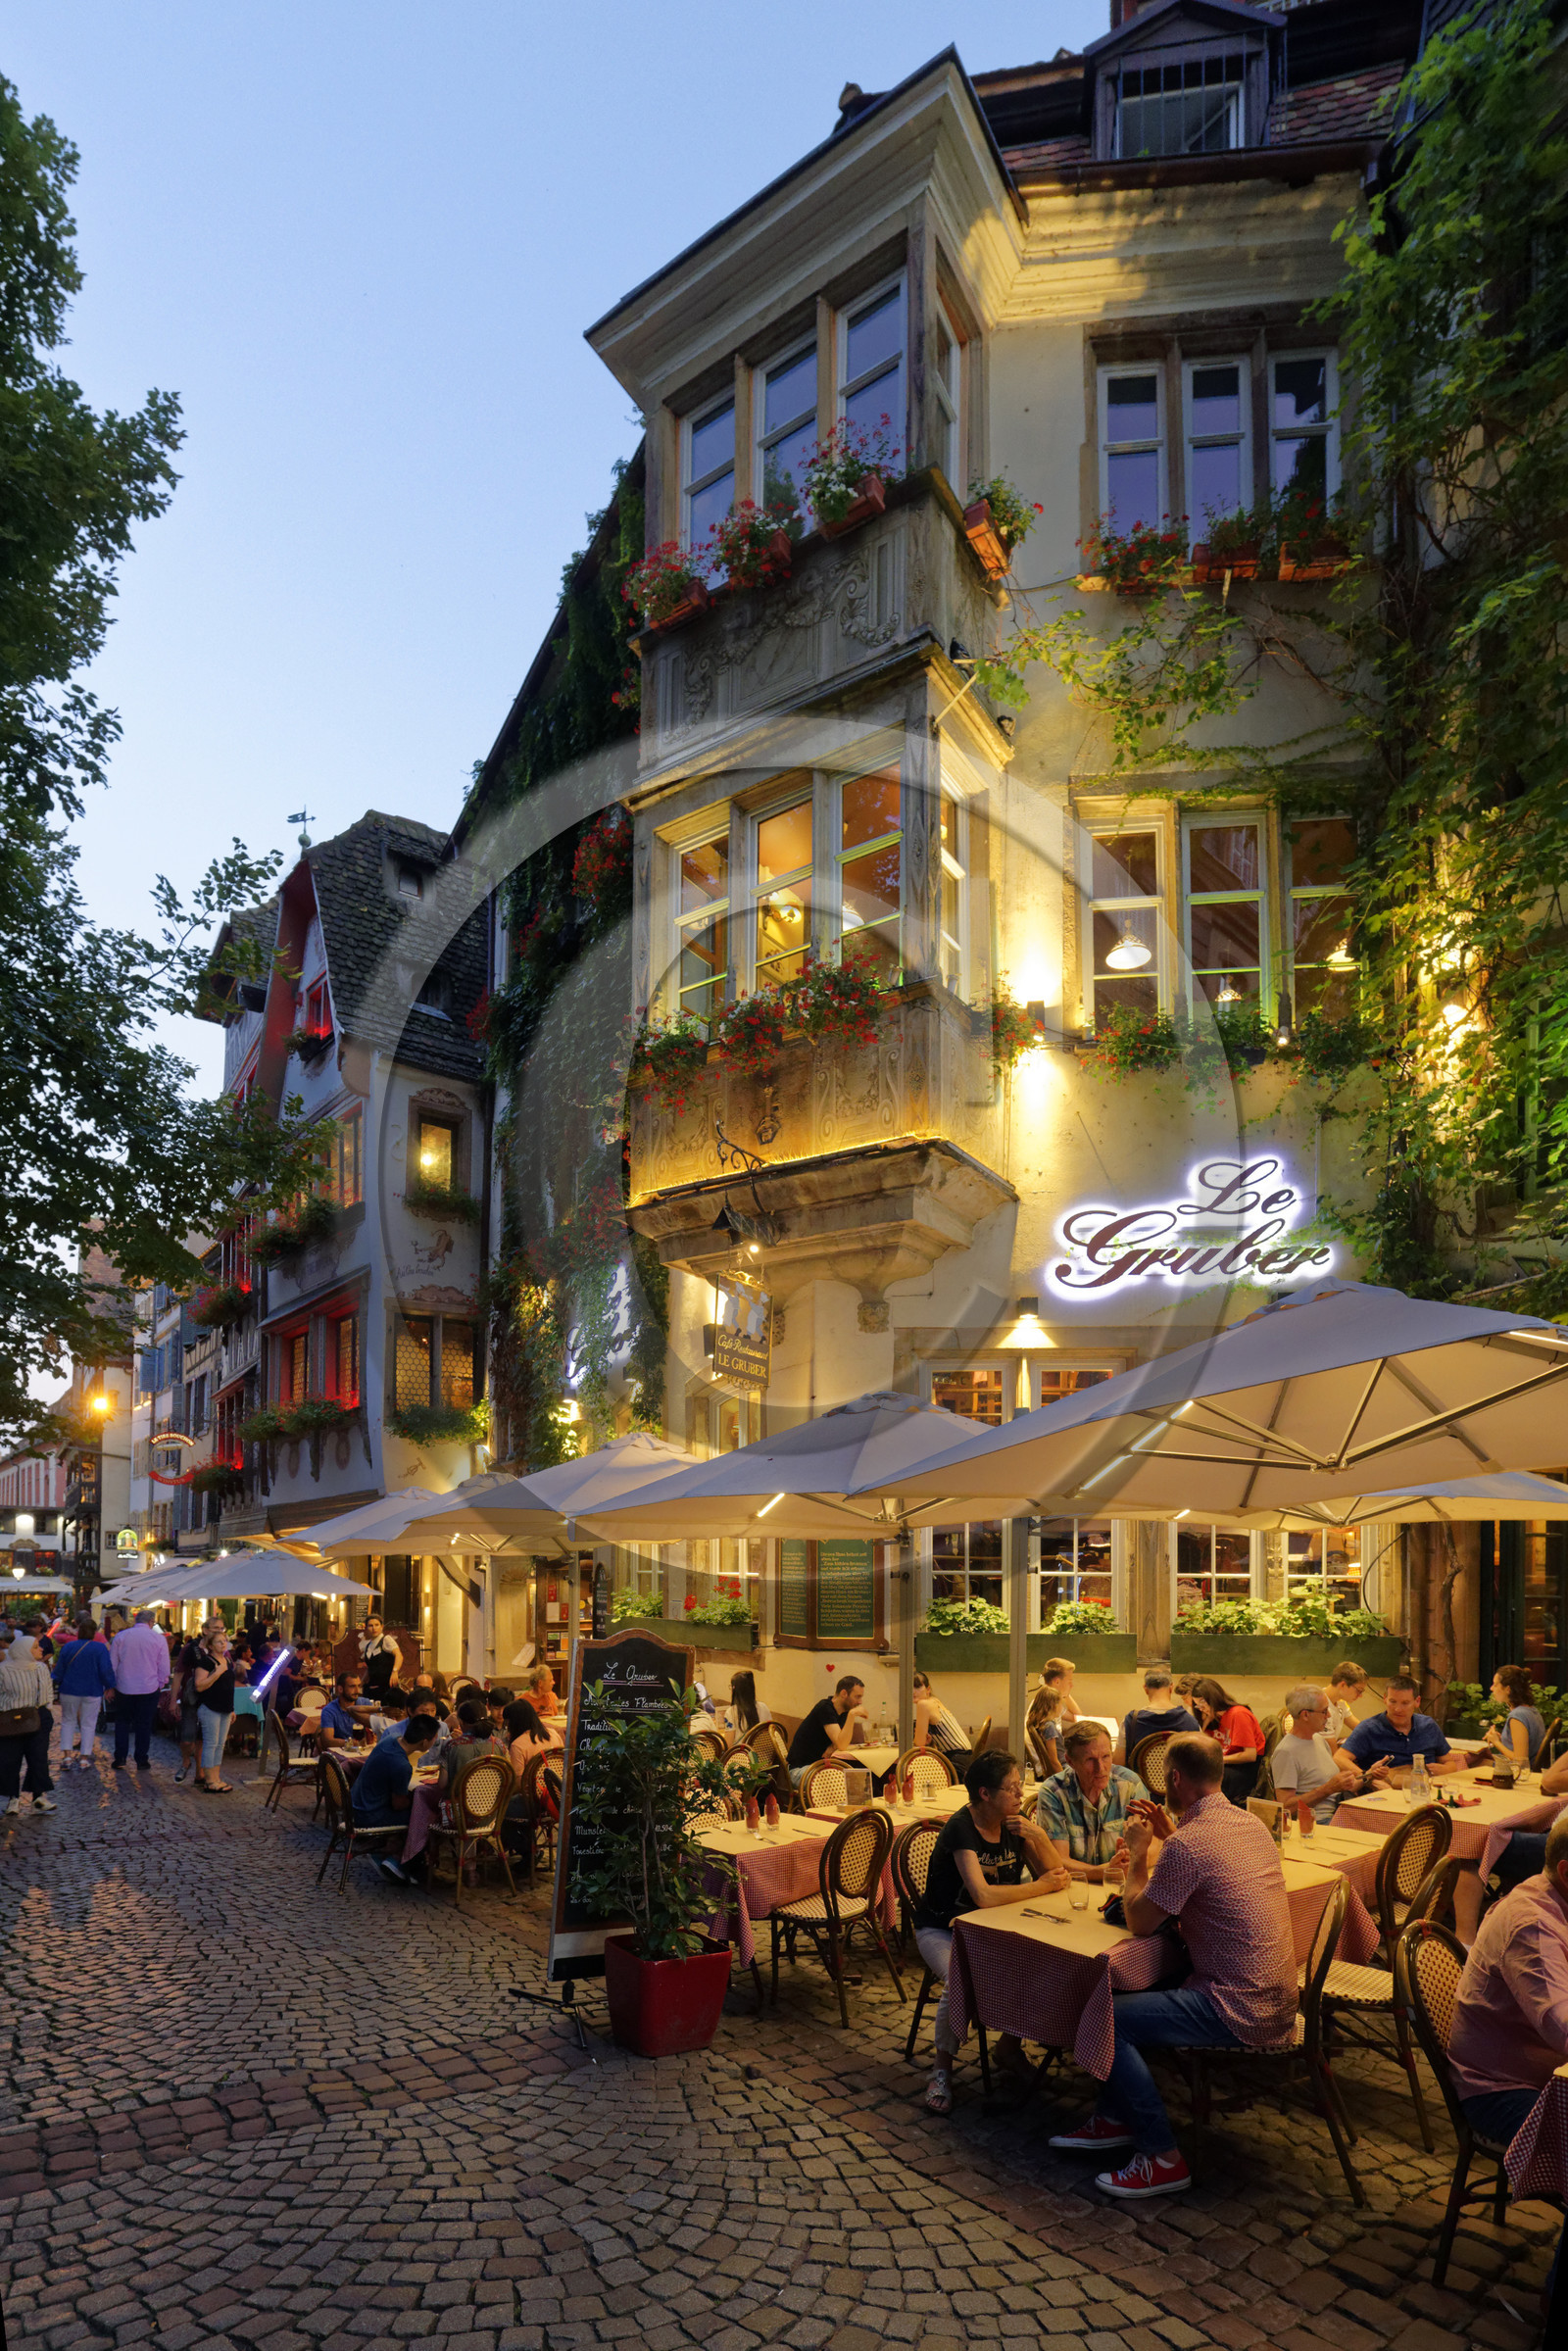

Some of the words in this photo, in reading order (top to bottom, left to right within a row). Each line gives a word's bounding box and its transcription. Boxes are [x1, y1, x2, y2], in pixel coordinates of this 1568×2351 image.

[1177, 1159, 1297, 1214] Le
[1055, 1210, 1330, 1288] Gruber
[718, 1353, 730, 1367] LE
[731, 1357, 767, 1378] GRUBER
[604, 1662, 618, 1680] Le
